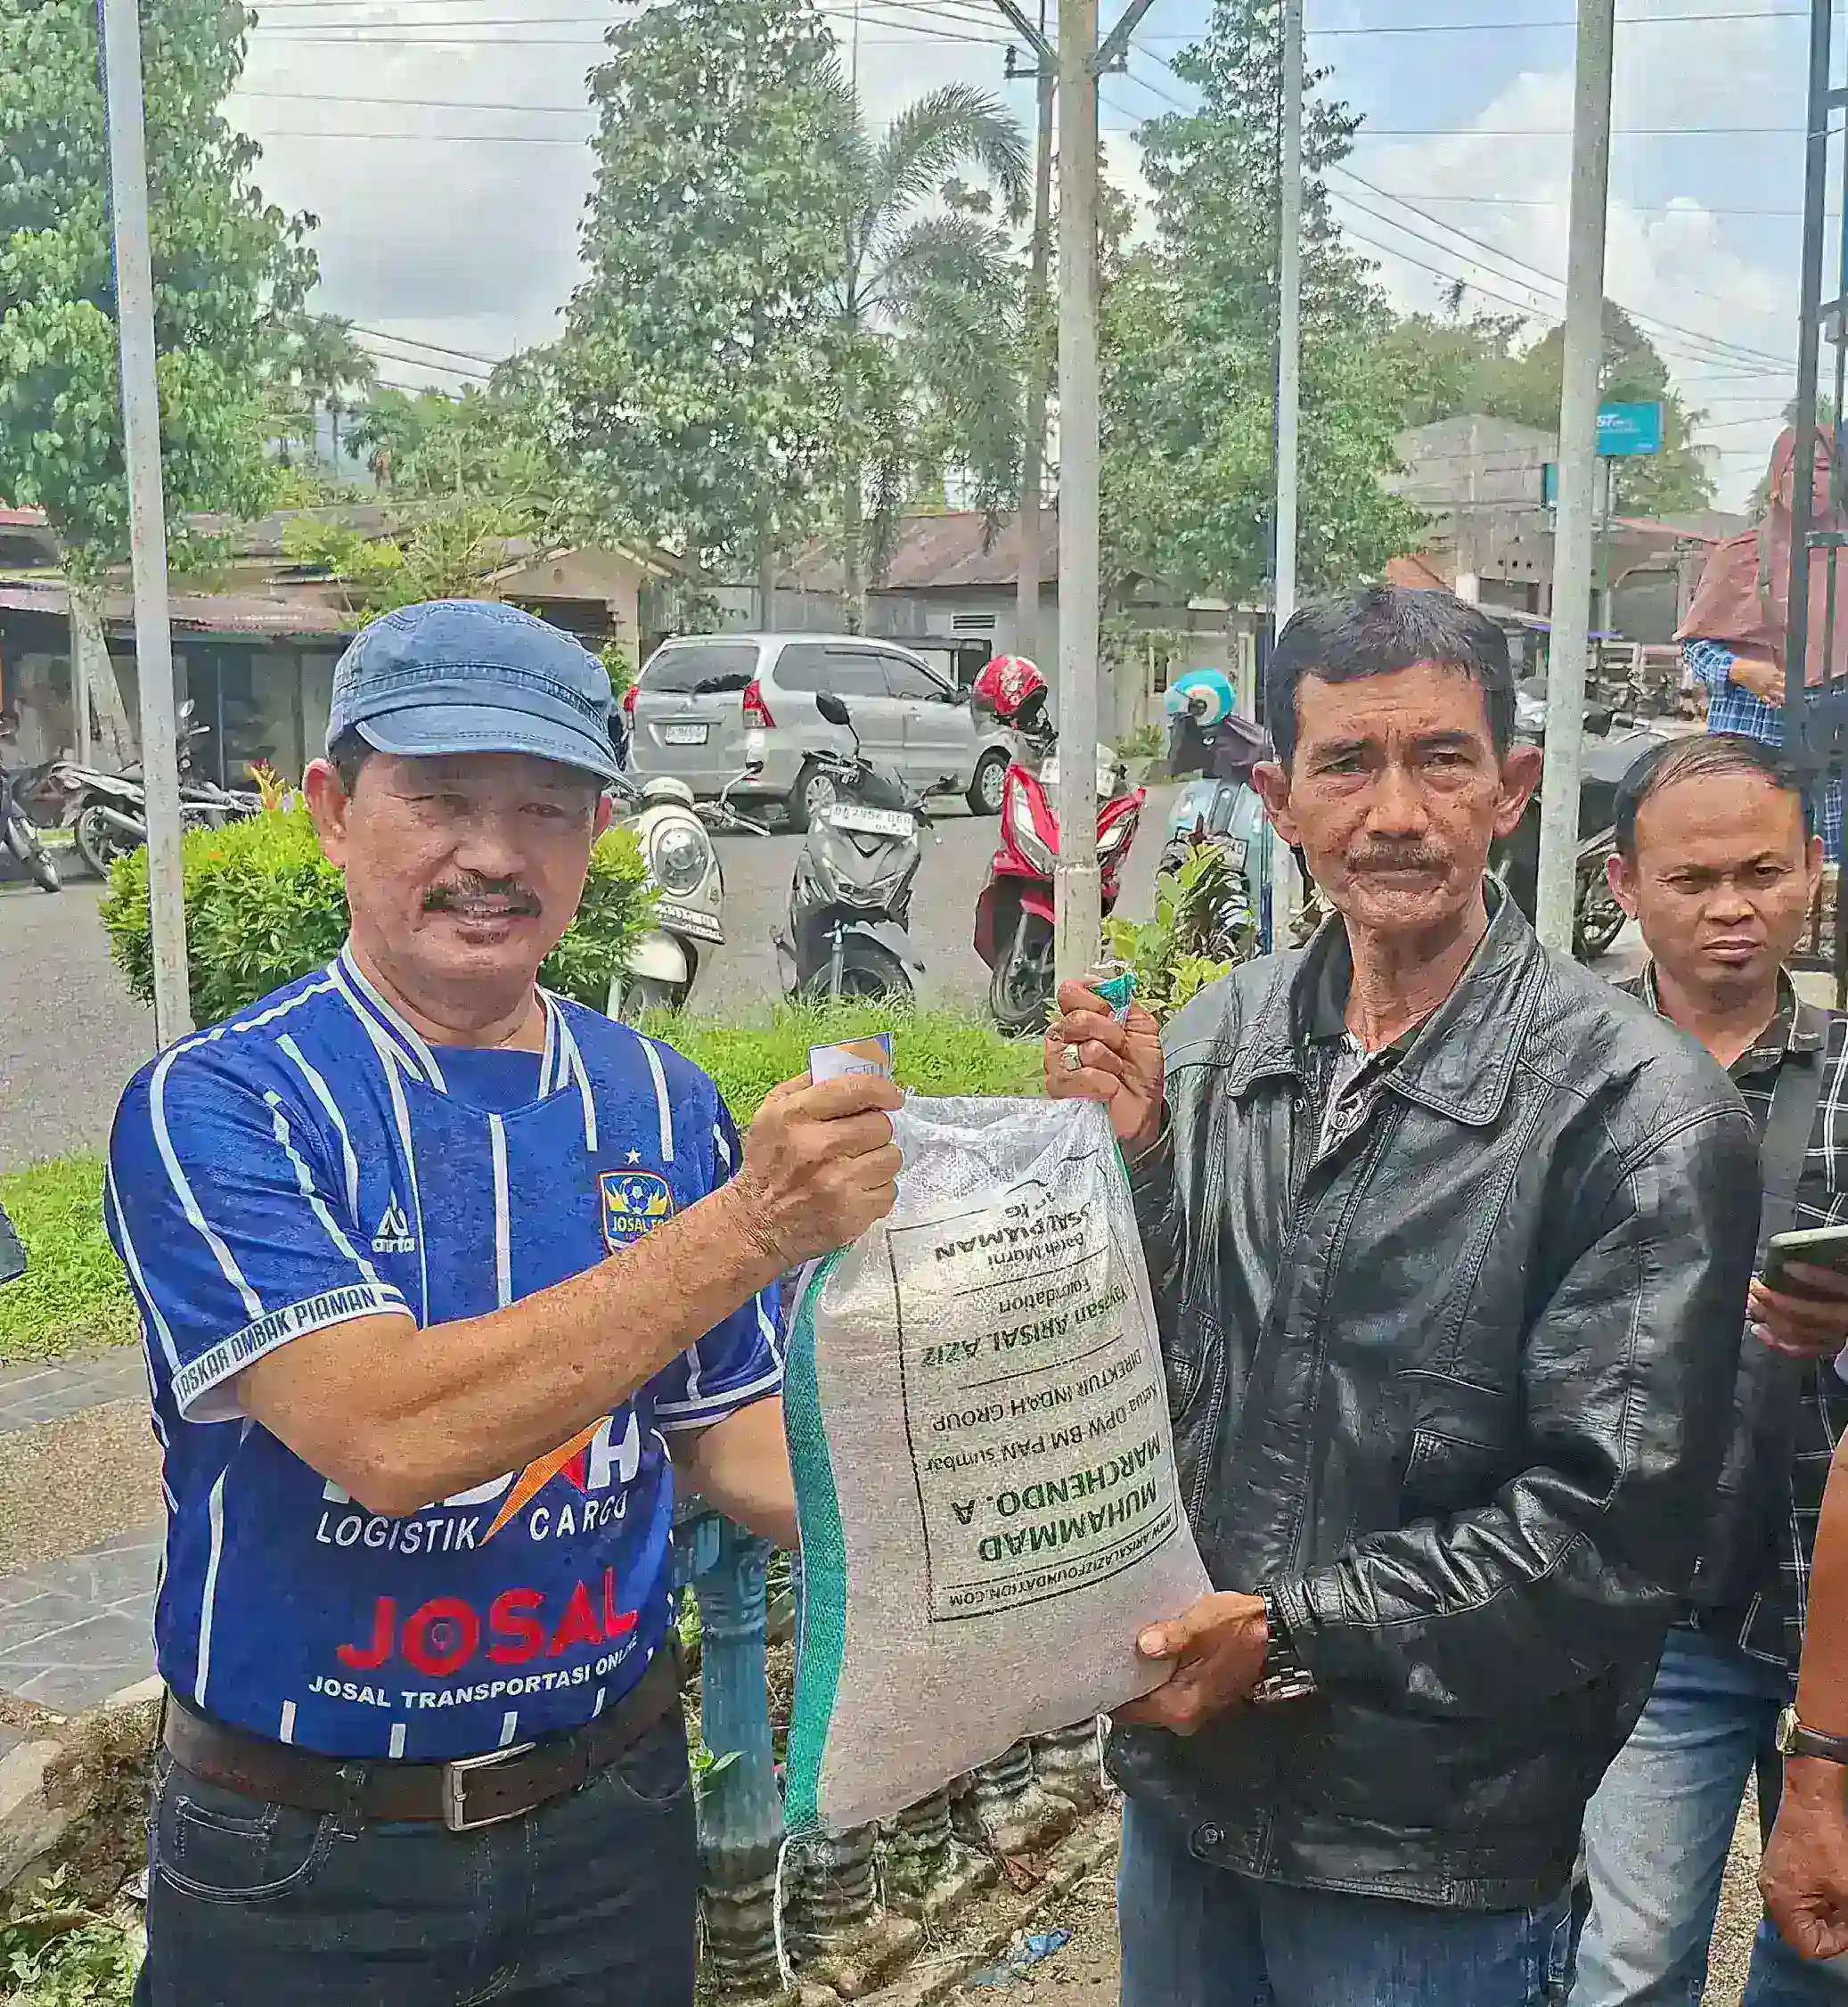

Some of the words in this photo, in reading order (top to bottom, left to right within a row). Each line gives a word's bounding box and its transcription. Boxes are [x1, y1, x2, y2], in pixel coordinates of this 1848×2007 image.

[612, 1215, 649, 1232] JOSAL
[230, 1310, 292, 1362] OMBAK
[293, 1286, 379, 1329] PIAMAN
[986, 1313, 1069, 1353] ARISAL
[920, 1337, 982, 1368] AZIZ
[1074, 1347, 1143, 1400] DIREKTUR
[931, 1402, 1004, 1432] GROUP
[1010, 1389, 1074, 1419] INDAH
[1051, 1423, 1083, 1451] BM
[1088, 1407, 1127, 1440] DPW
[925, 1449, 996, 1474] sumbar
[1002, 1434, 1047, 1462] PAN
[315, 1511, 482, 1554] LOGISTIK
[529, 1489, 629, 1541] CARGO
[950, 1498, 976, 1526] A
[977, 1476, 1157, 1562] MUHAMMAD
[336, 1565, 638, 1678] JOSAL
[308, 1675, 392, 1708] JOSAL
[401, 1664, 591, 1709] TRANSPORTASI
